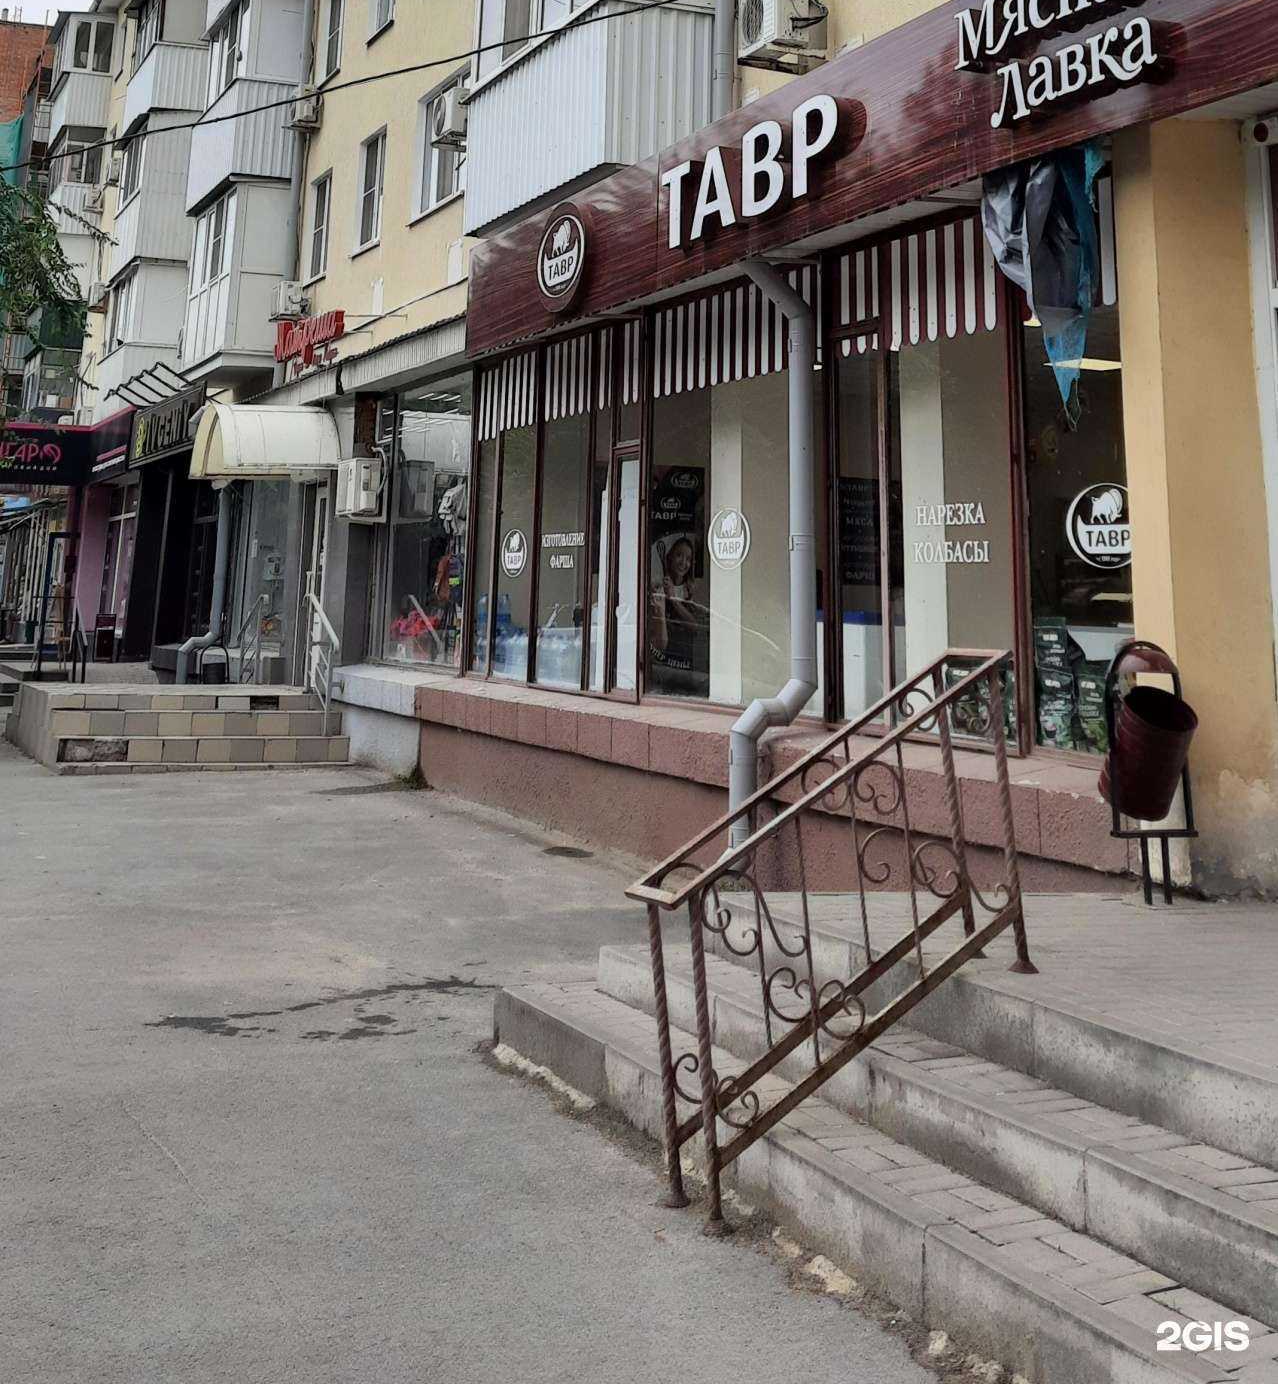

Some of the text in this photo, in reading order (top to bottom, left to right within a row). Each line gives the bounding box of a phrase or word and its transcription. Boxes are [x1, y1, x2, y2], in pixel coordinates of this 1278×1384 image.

[662, 94, 838, 249] ТАВР
[548, 256, 574, 280] ТАВР
[916, 502, 986, 526] НАРЕЗКА
[717, 541, 741, 555] ТАВР
[1085, 529, 1131, 548] ТАВР
[913, 540, 990, 564] КОЛБАСЫ
